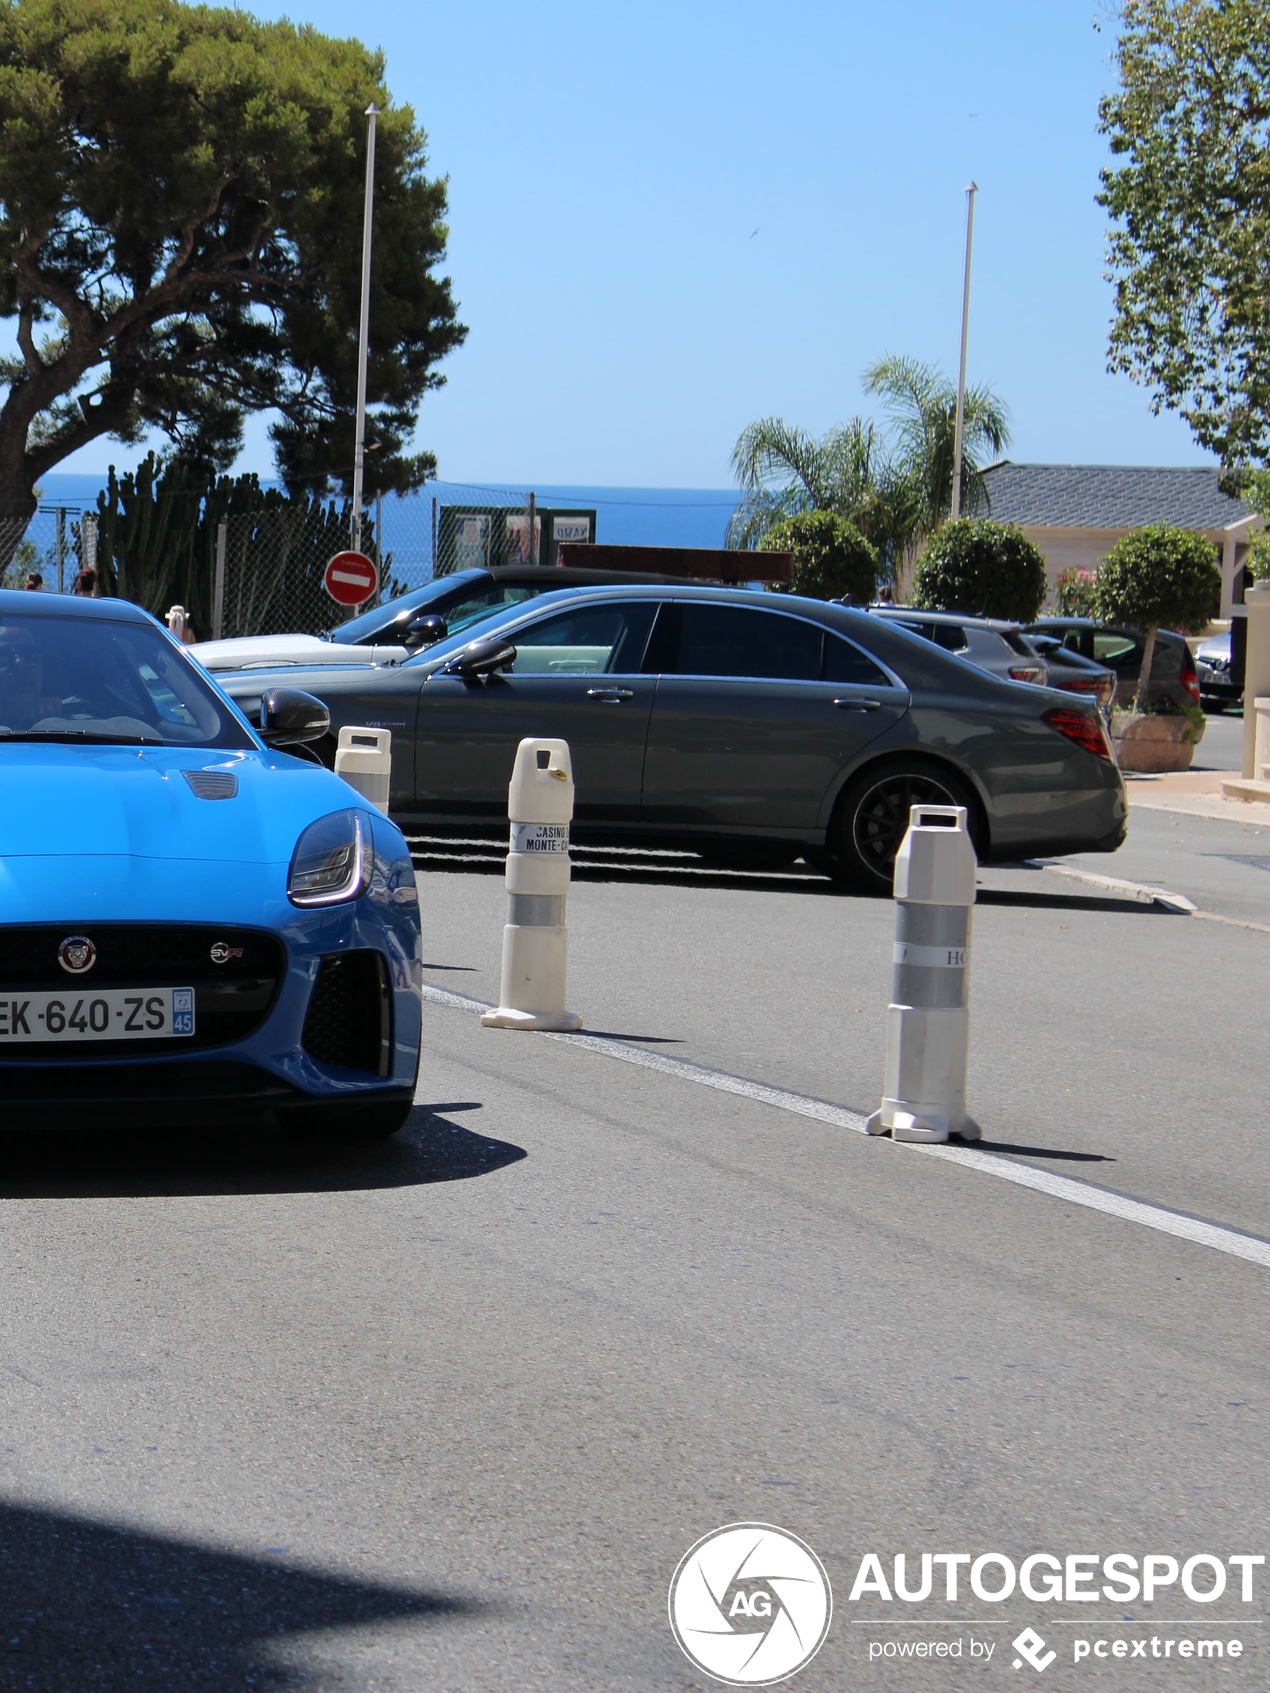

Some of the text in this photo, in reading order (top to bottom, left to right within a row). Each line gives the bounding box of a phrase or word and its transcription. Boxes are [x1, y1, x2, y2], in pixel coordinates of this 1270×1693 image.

[536, 826, 565, 838] CASINO
[210, 947, 243, 958] SVR
[174, 1014, 192, 1032] 45
